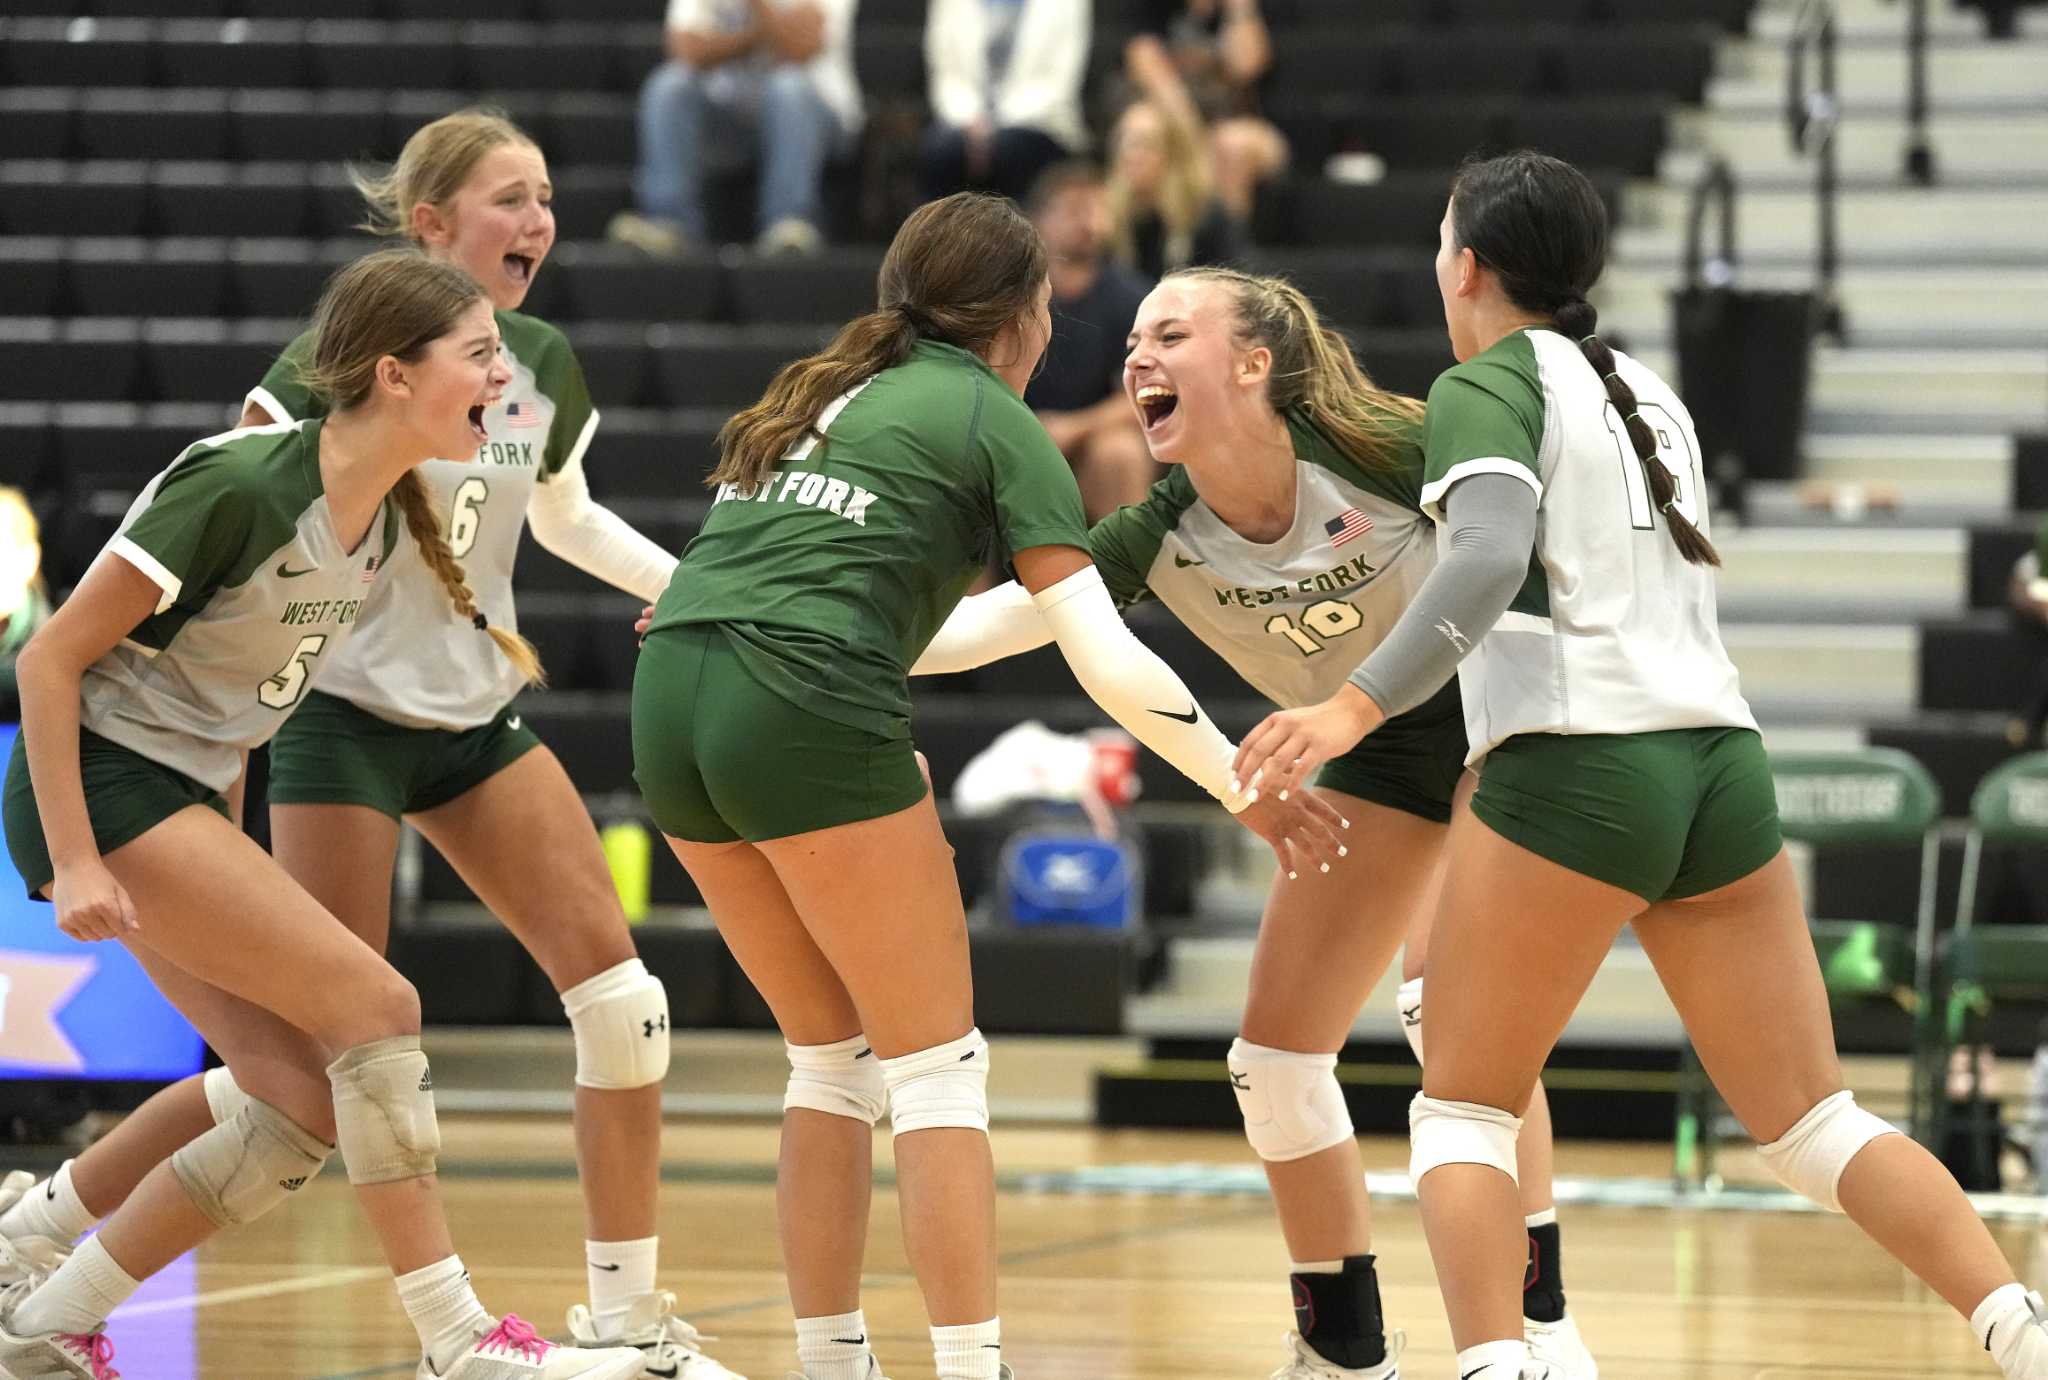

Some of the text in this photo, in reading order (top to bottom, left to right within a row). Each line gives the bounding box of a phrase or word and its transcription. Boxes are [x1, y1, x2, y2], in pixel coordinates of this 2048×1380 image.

[479, 442, 533, 466] FORK
[447, 476, 489, 559] 6
[777, 471, 879, 527] FORK
[1214, 553, 1376, 608] WEST FORK
[280, 600, 330, 625] WEST
[257, 634, 327, 711] 5
